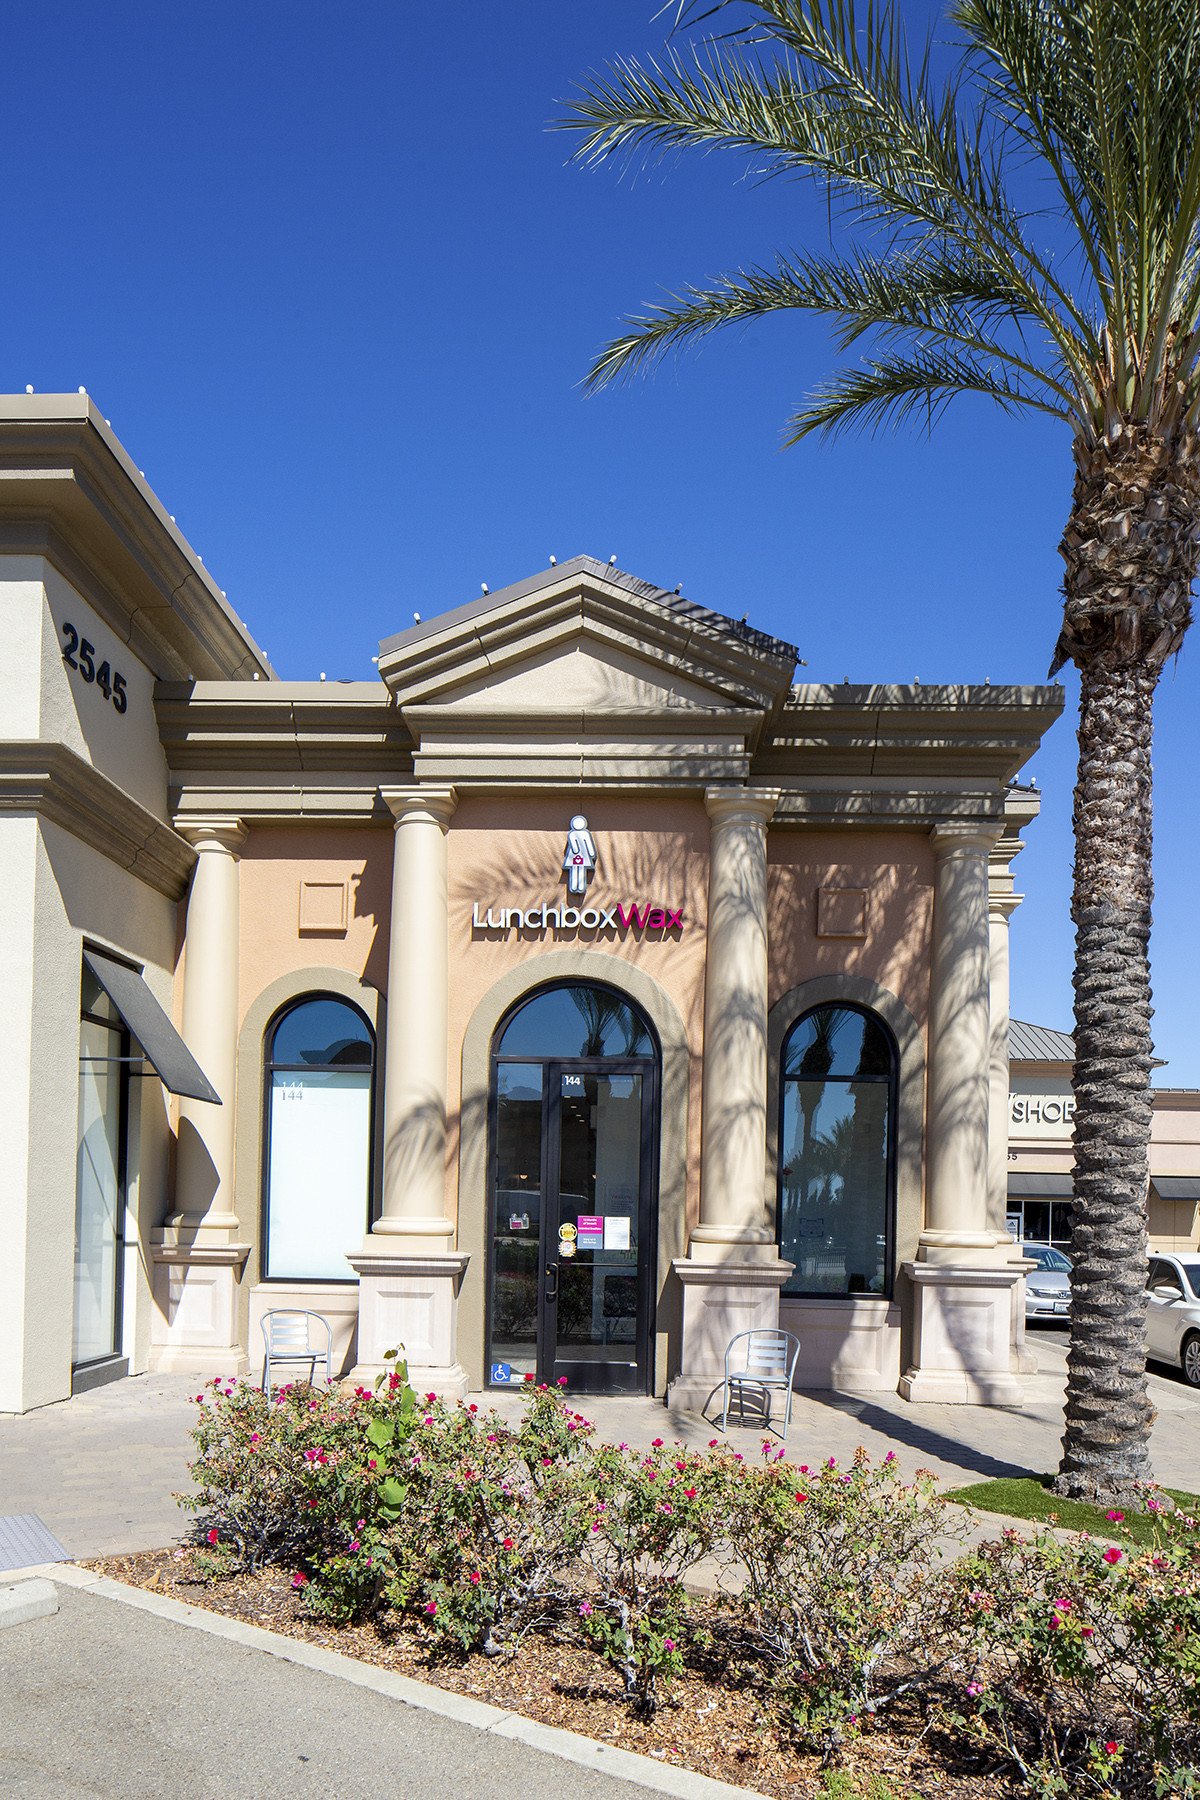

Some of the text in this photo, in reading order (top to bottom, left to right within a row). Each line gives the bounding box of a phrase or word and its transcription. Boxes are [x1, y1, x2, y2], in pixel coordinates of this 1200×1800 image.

[62, 622, 128, 714] 2545
[472, 901, 685, 929] LunchboxWax
[281, 1081, 304, 1101] 144
[564, 1074, 581, 1086] 144
